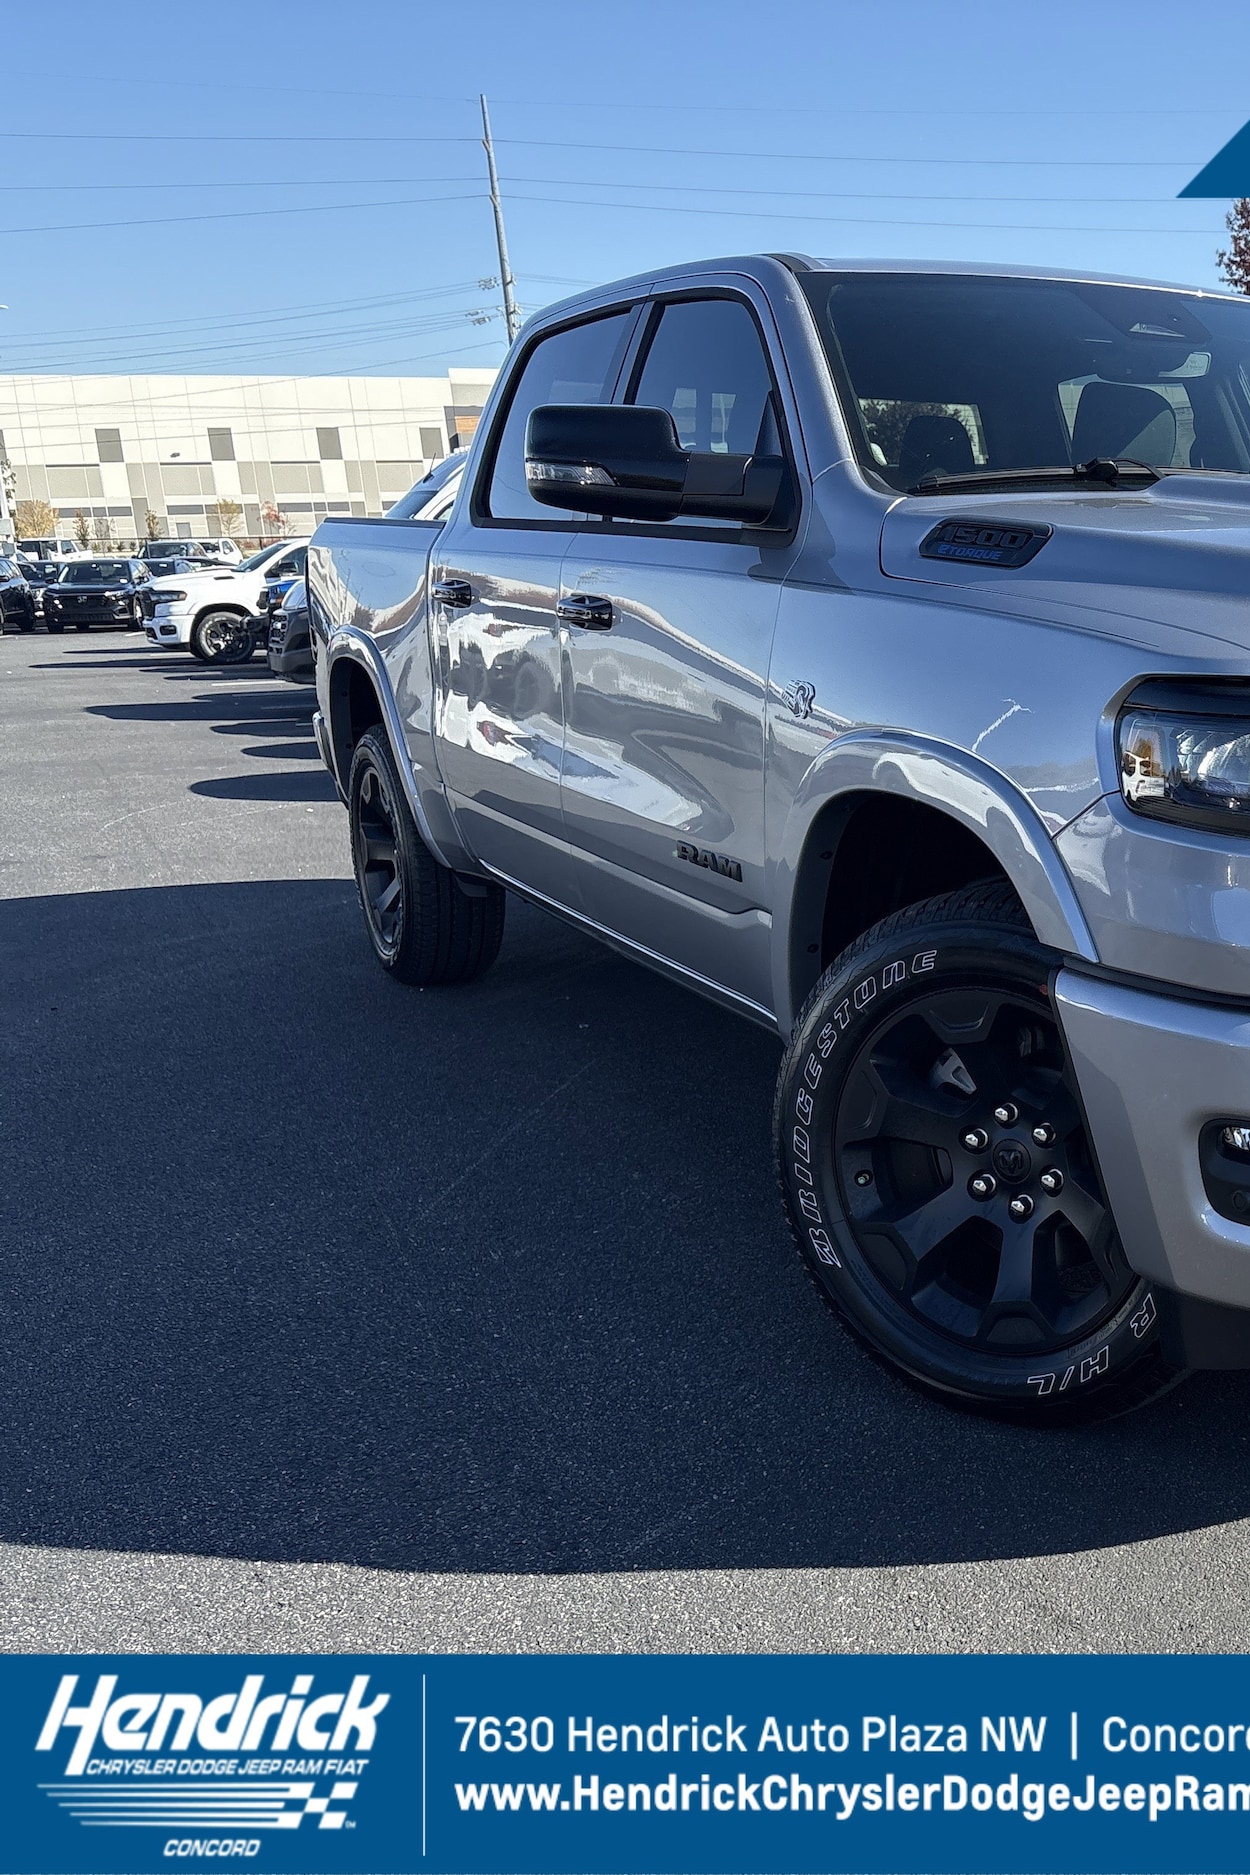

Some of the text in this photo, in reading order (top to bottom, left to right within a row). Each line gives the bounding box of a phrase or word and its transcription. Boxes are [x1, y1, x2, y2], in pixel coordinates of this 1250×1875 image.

[941, 526, 1027, 548] 1500
[675, 839, 744, 883] RAM
[793, 949, 938, 1268] BRIDGESTONE
